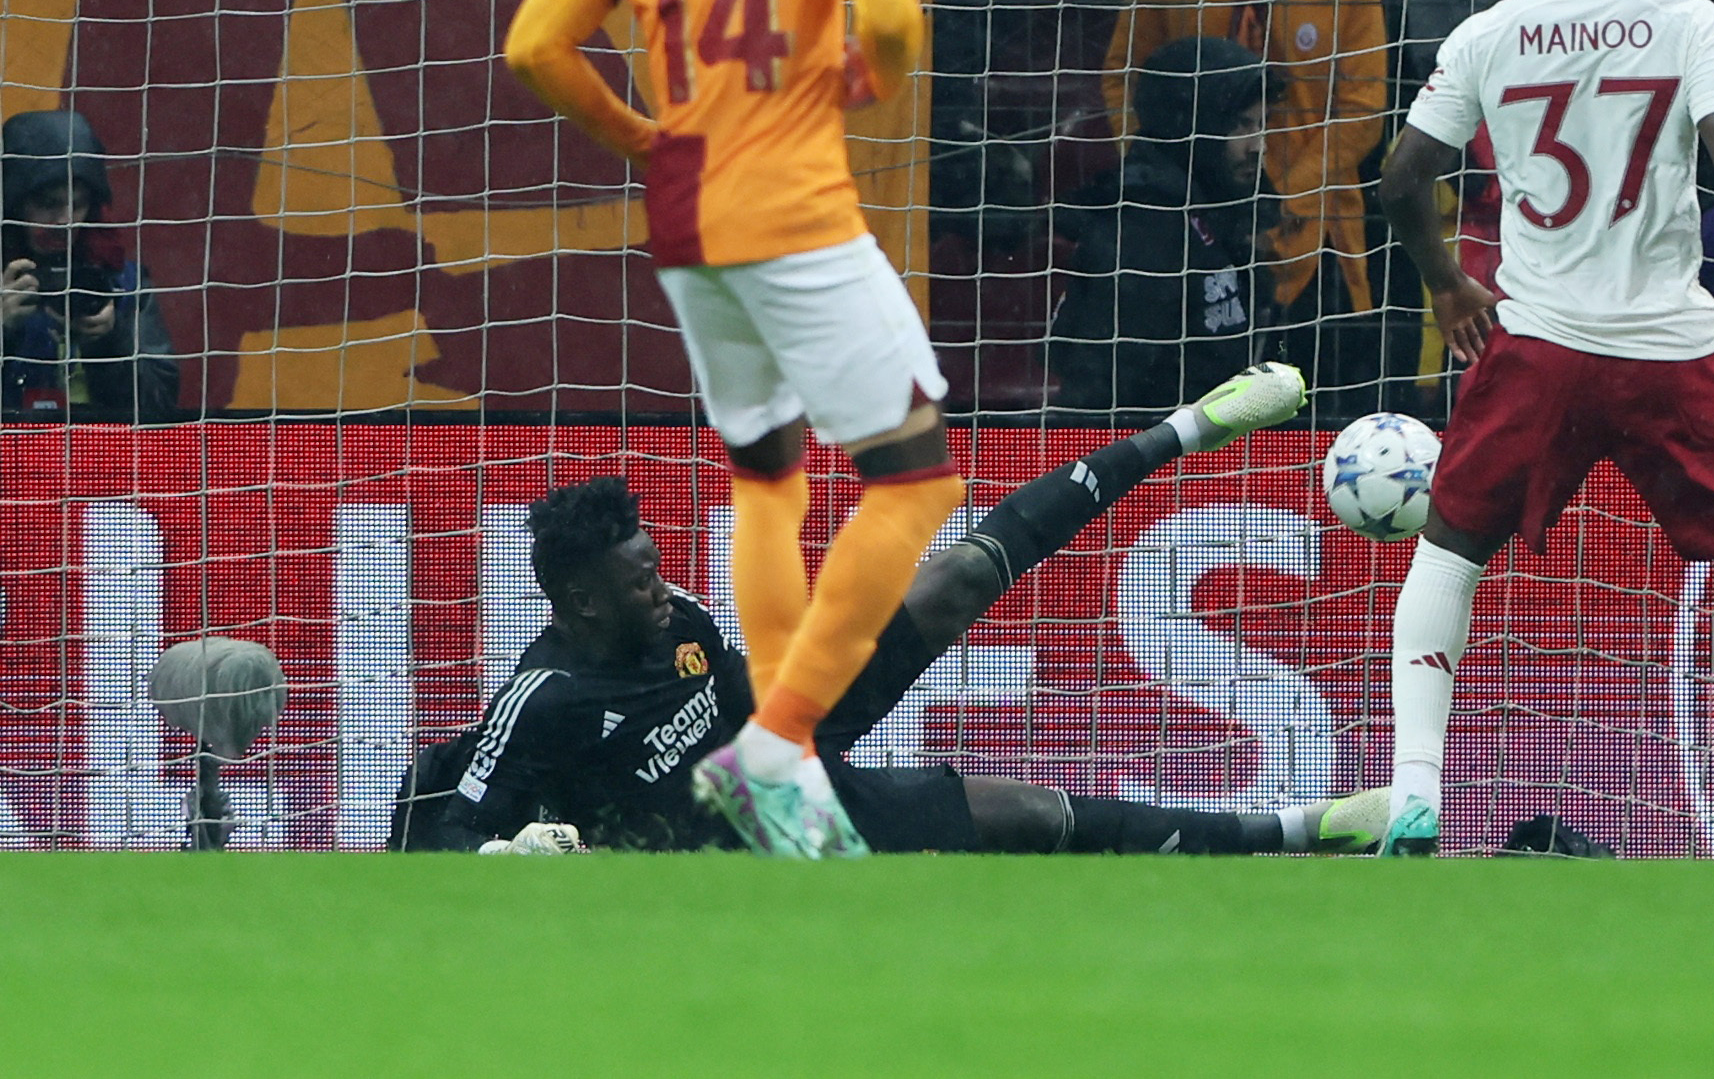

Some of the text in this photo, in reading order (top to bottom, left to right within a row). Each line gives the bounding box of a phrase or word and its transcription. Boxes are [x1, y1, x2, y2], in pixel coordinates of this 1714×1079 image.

[1519, 19, 1654, 56] MAINOO
[1497, 75, 1683, 231] 37
[634, 707, 712, 784] Viewer
[643, 690, 710, 754] Team
